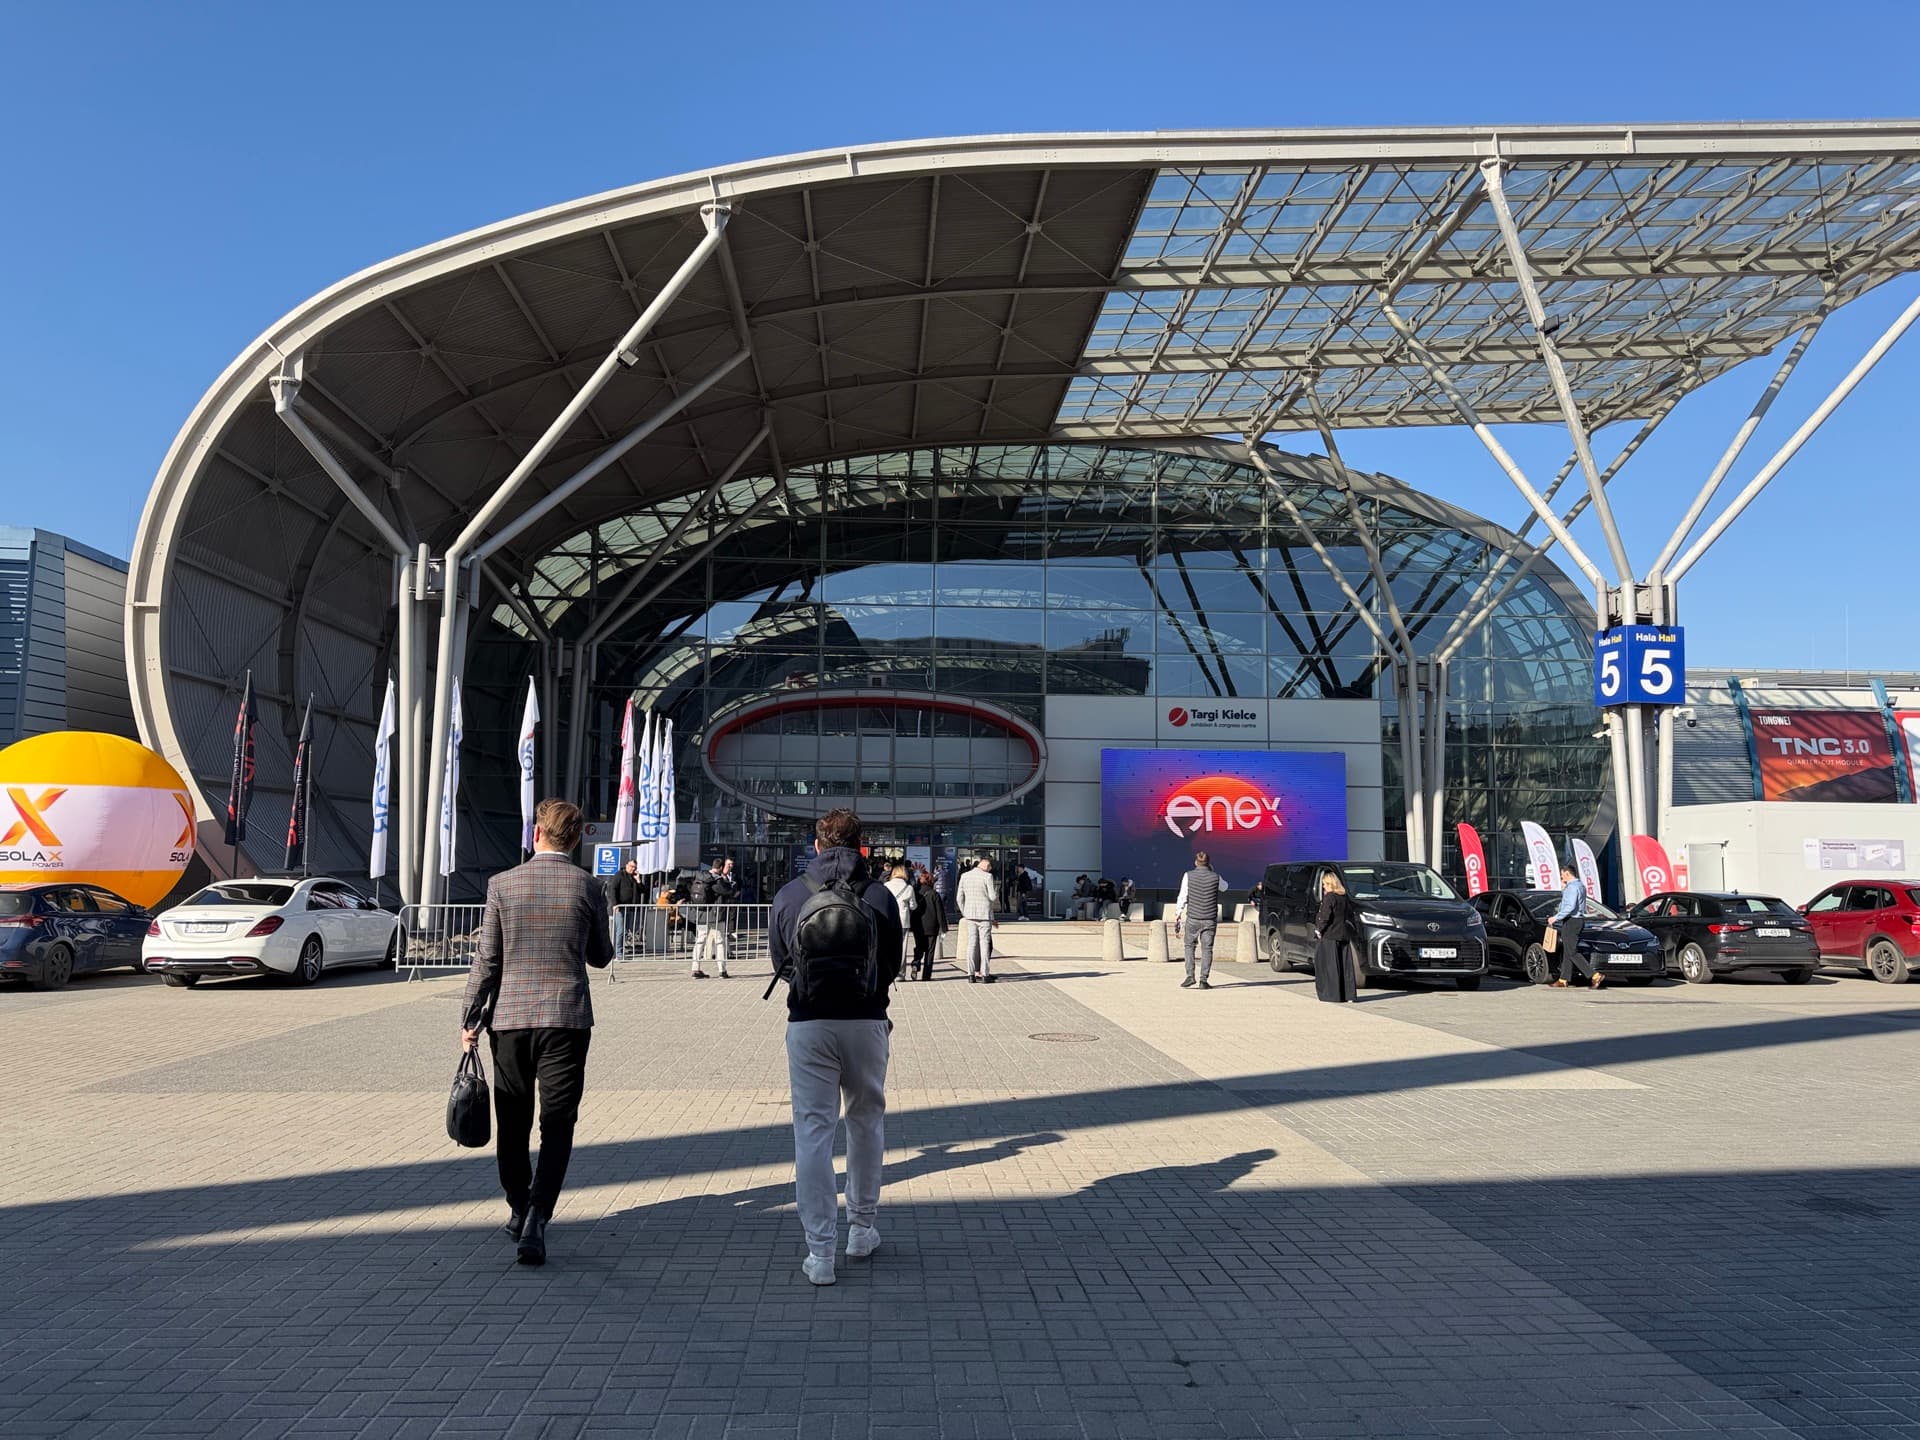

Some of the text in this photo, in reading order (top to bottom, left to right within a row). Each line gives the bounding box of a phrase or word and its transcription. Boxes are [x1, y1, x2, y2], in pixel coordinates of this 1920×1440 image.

[1599, 634, 1622, 647] Hala Hall
[1635, 633, 1676, 642] Hala Hall
[1601, 651, 1620, 697] 5
[1640, 649, 1673, 695] 5
[1190, 708, 1256, 721] Targi Kielce
[1758, 715, 1791, 726] TONGWEI
[1771, 737, 1870, 755] TNC 3.0
[1164, 795, 1282, 838] enex
